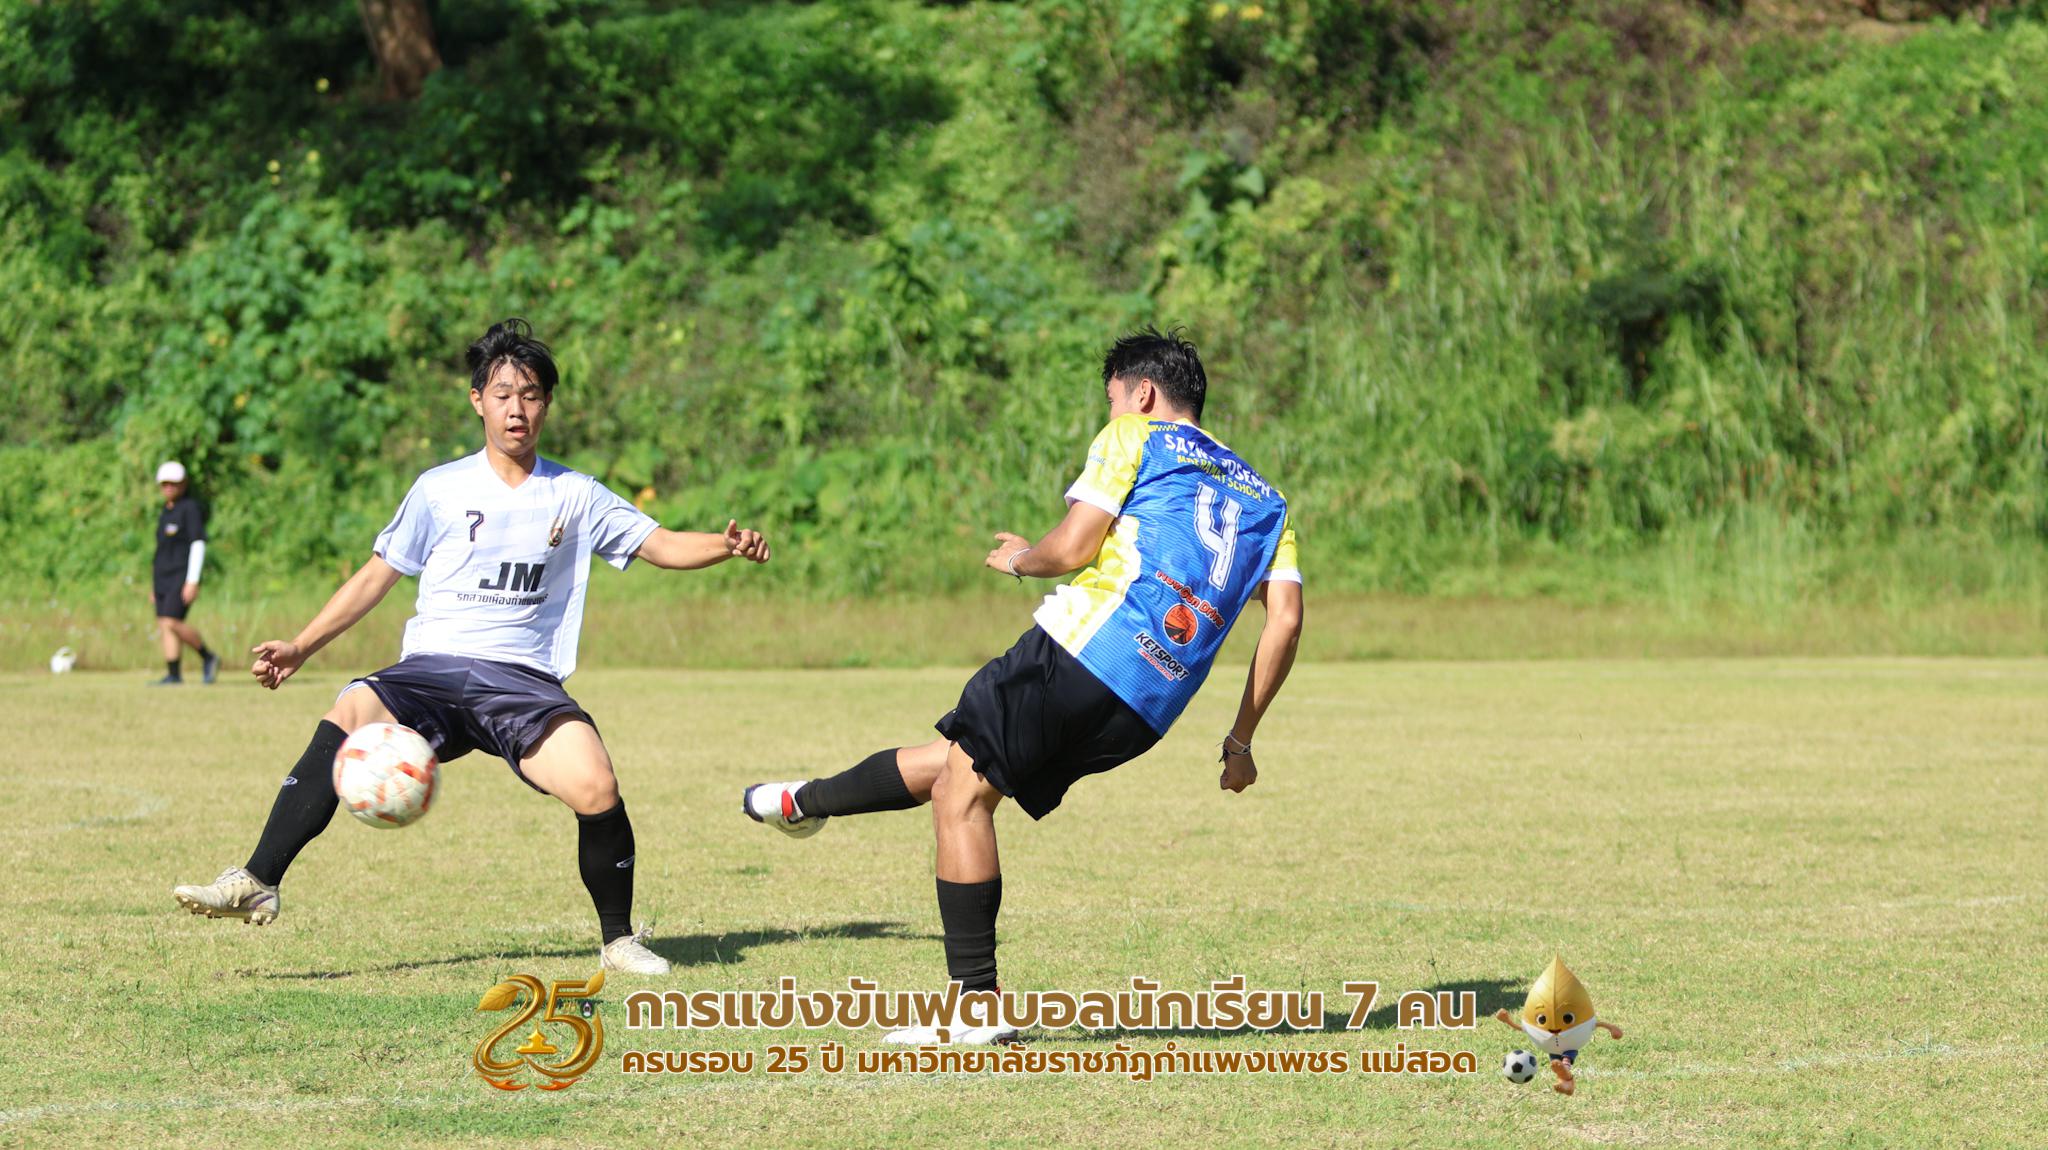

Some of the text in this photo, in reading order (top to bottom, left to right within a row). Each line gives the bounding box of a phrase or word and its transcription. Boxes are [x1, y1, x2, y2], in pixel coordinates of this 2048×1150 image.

[1227, 477, 1263, 503] SCHOOL
[465, 510, 485, 542] 7
[1194, 481, 1243, 592] 4
[478, 562, 546, 592] JM
[1134, 632, 1189, 680] KETSPORT
